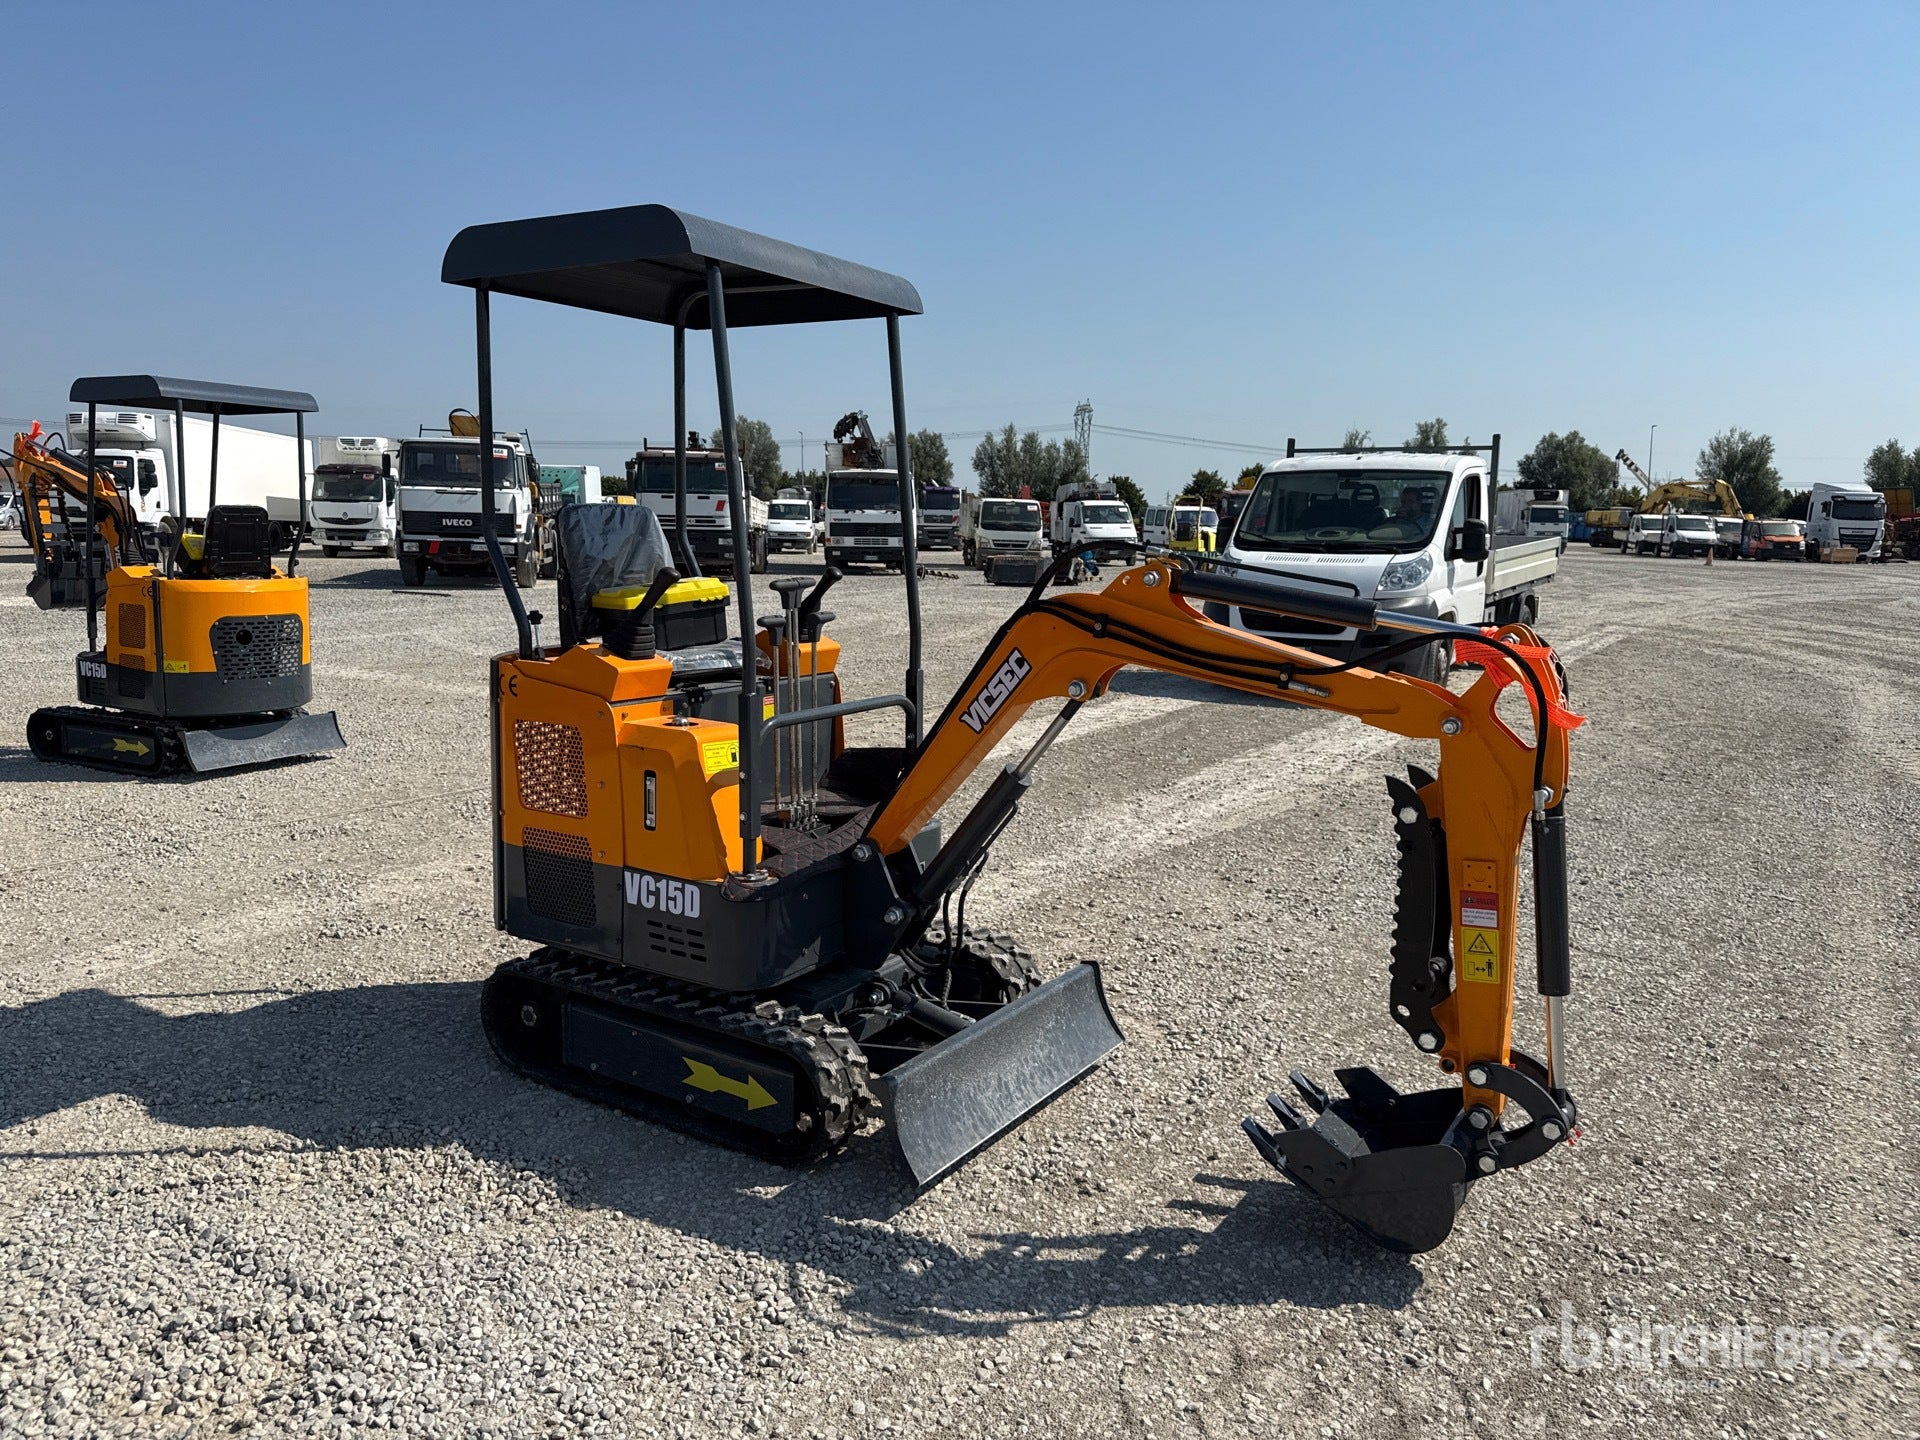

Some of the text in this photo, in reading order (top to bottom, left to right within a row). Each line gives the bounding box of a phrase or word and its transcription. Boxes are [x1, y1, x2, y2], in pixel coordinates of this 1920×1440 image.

[442, 518, 473, 527] IVECO
[80, 660, 107, 679] VC15D
[959, 647, 1032, 734] VICSEC
[623, 870, 701, 919] VC15D
